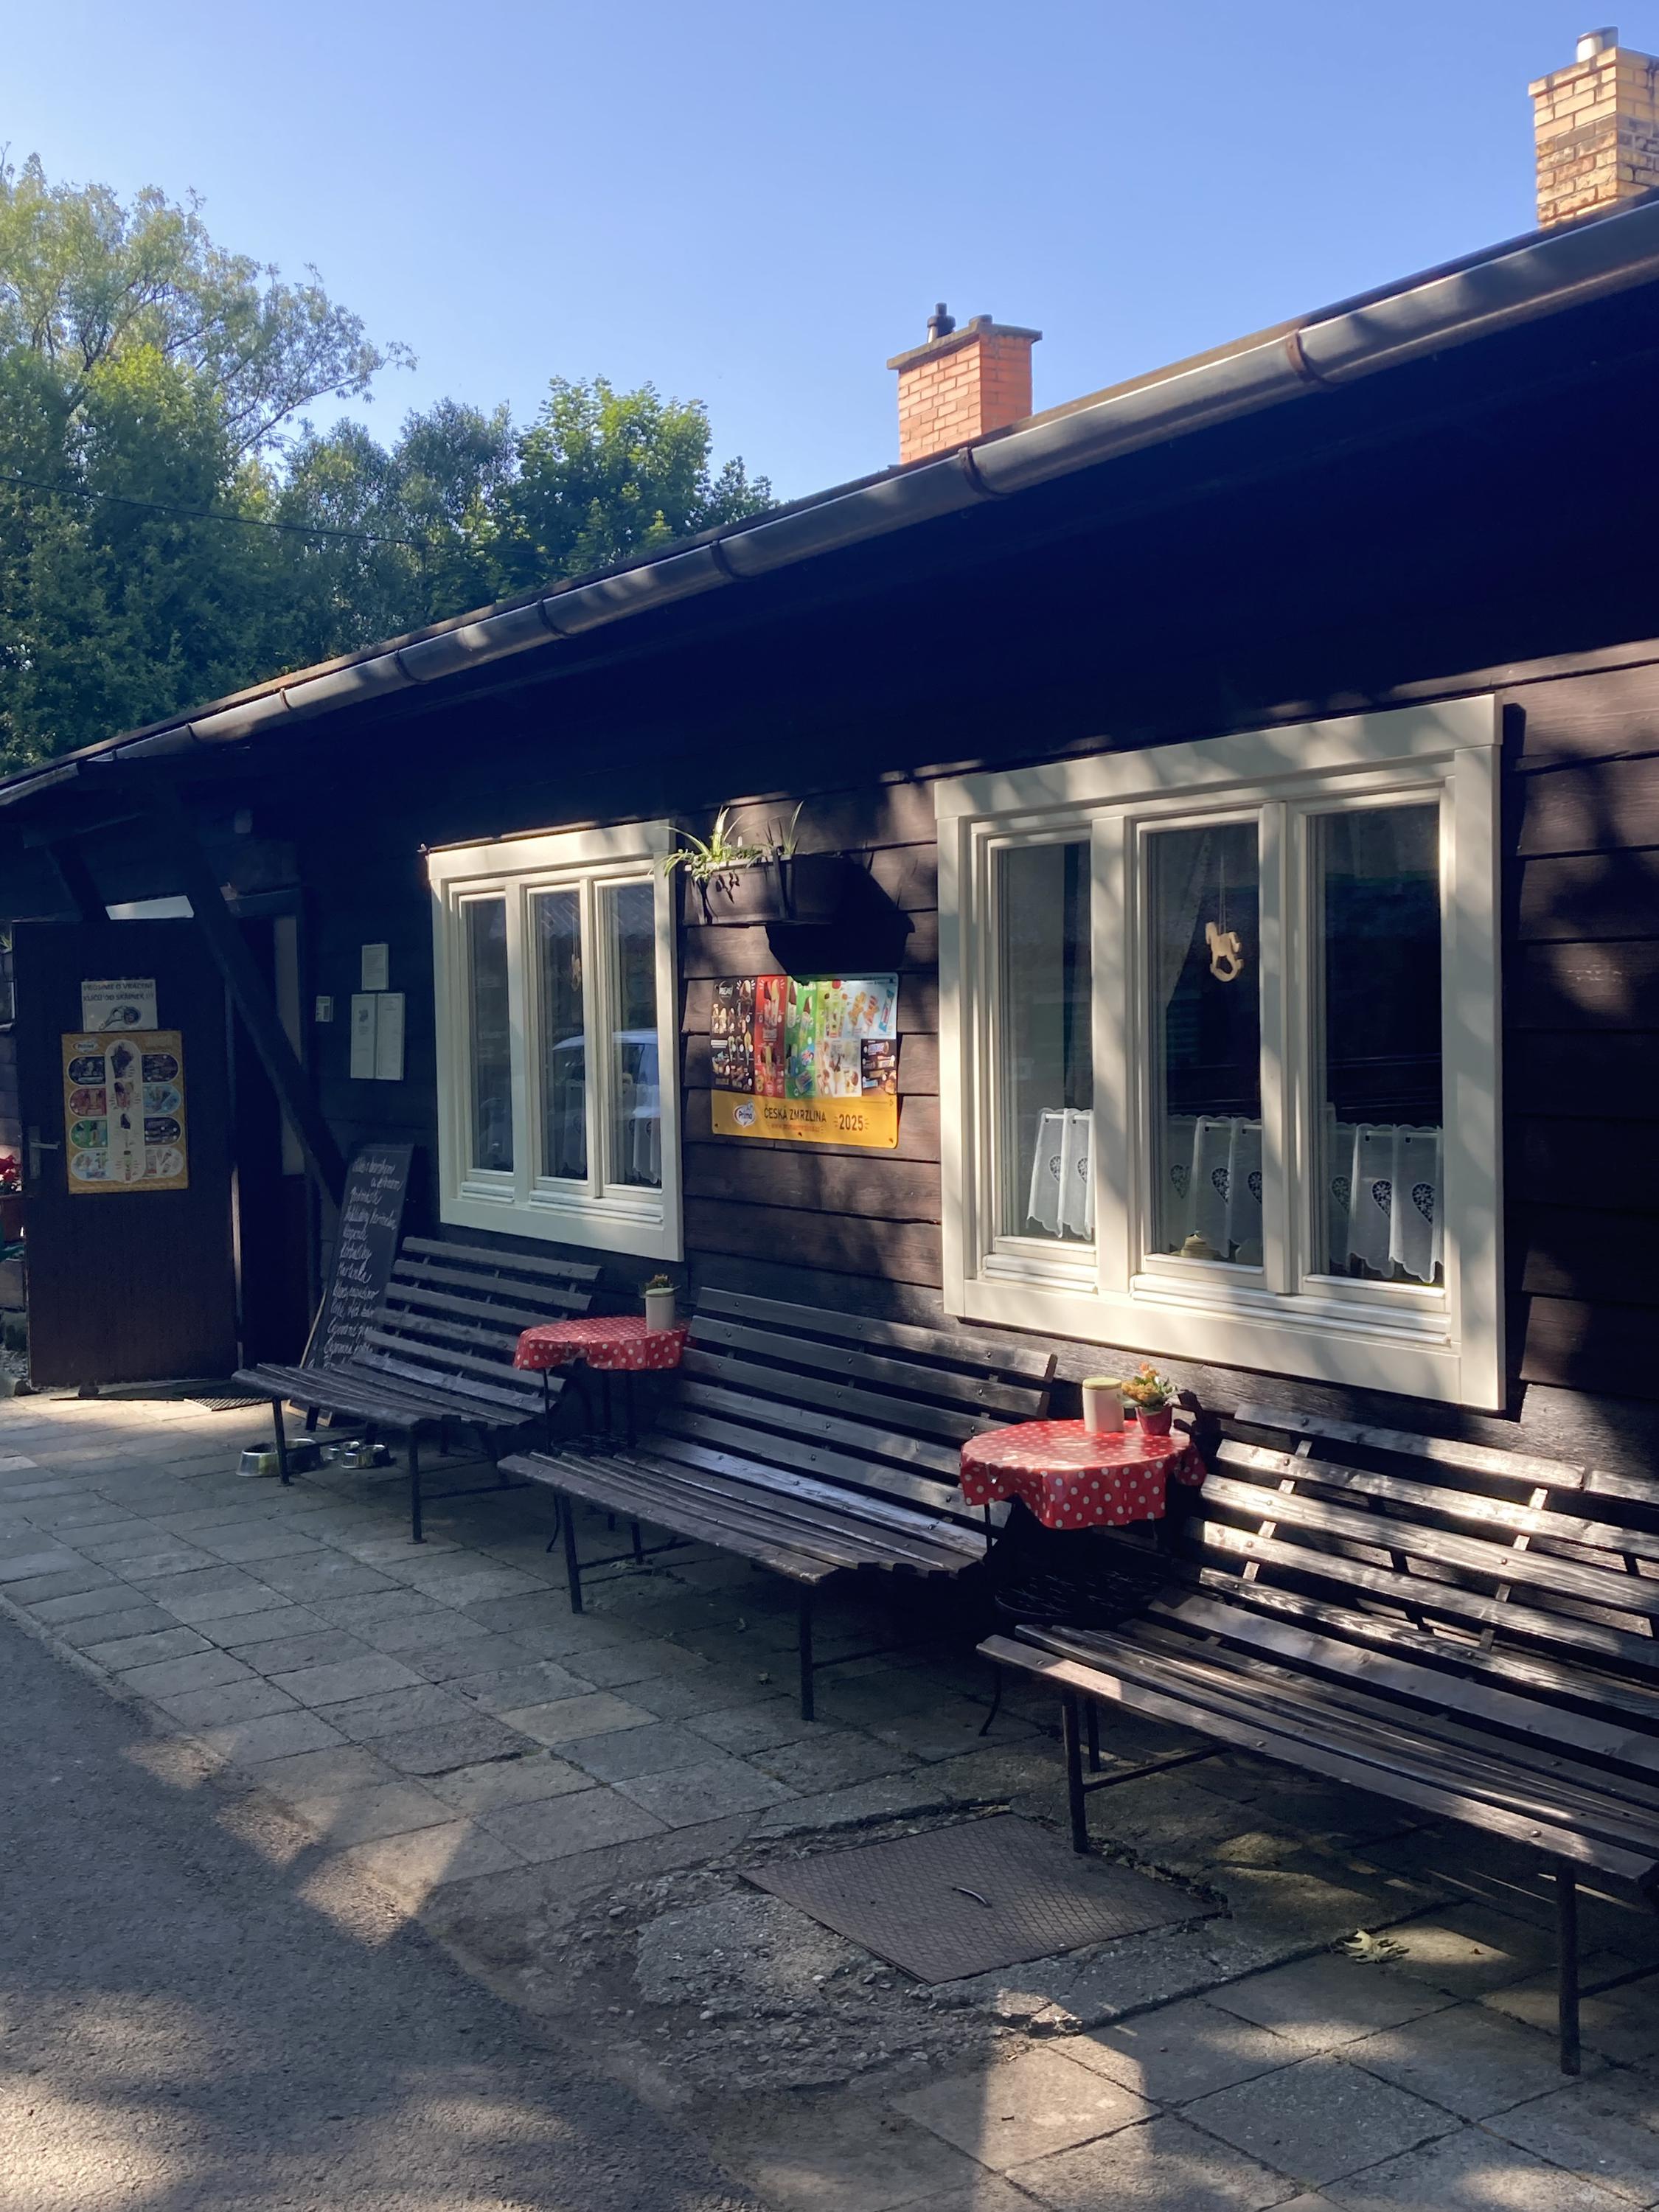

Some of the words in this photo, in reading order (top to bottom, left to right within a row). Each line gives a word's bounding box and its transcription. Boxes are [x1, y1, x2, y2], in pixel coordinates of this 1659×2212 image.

[738, 1110, 753, 1120] Prima
[764, 1104, 787, 1120] ČESKÁ
[790, 1108, 827, 1122] ZMRZLINA
[839, 1113, 863, 1131] 2025
